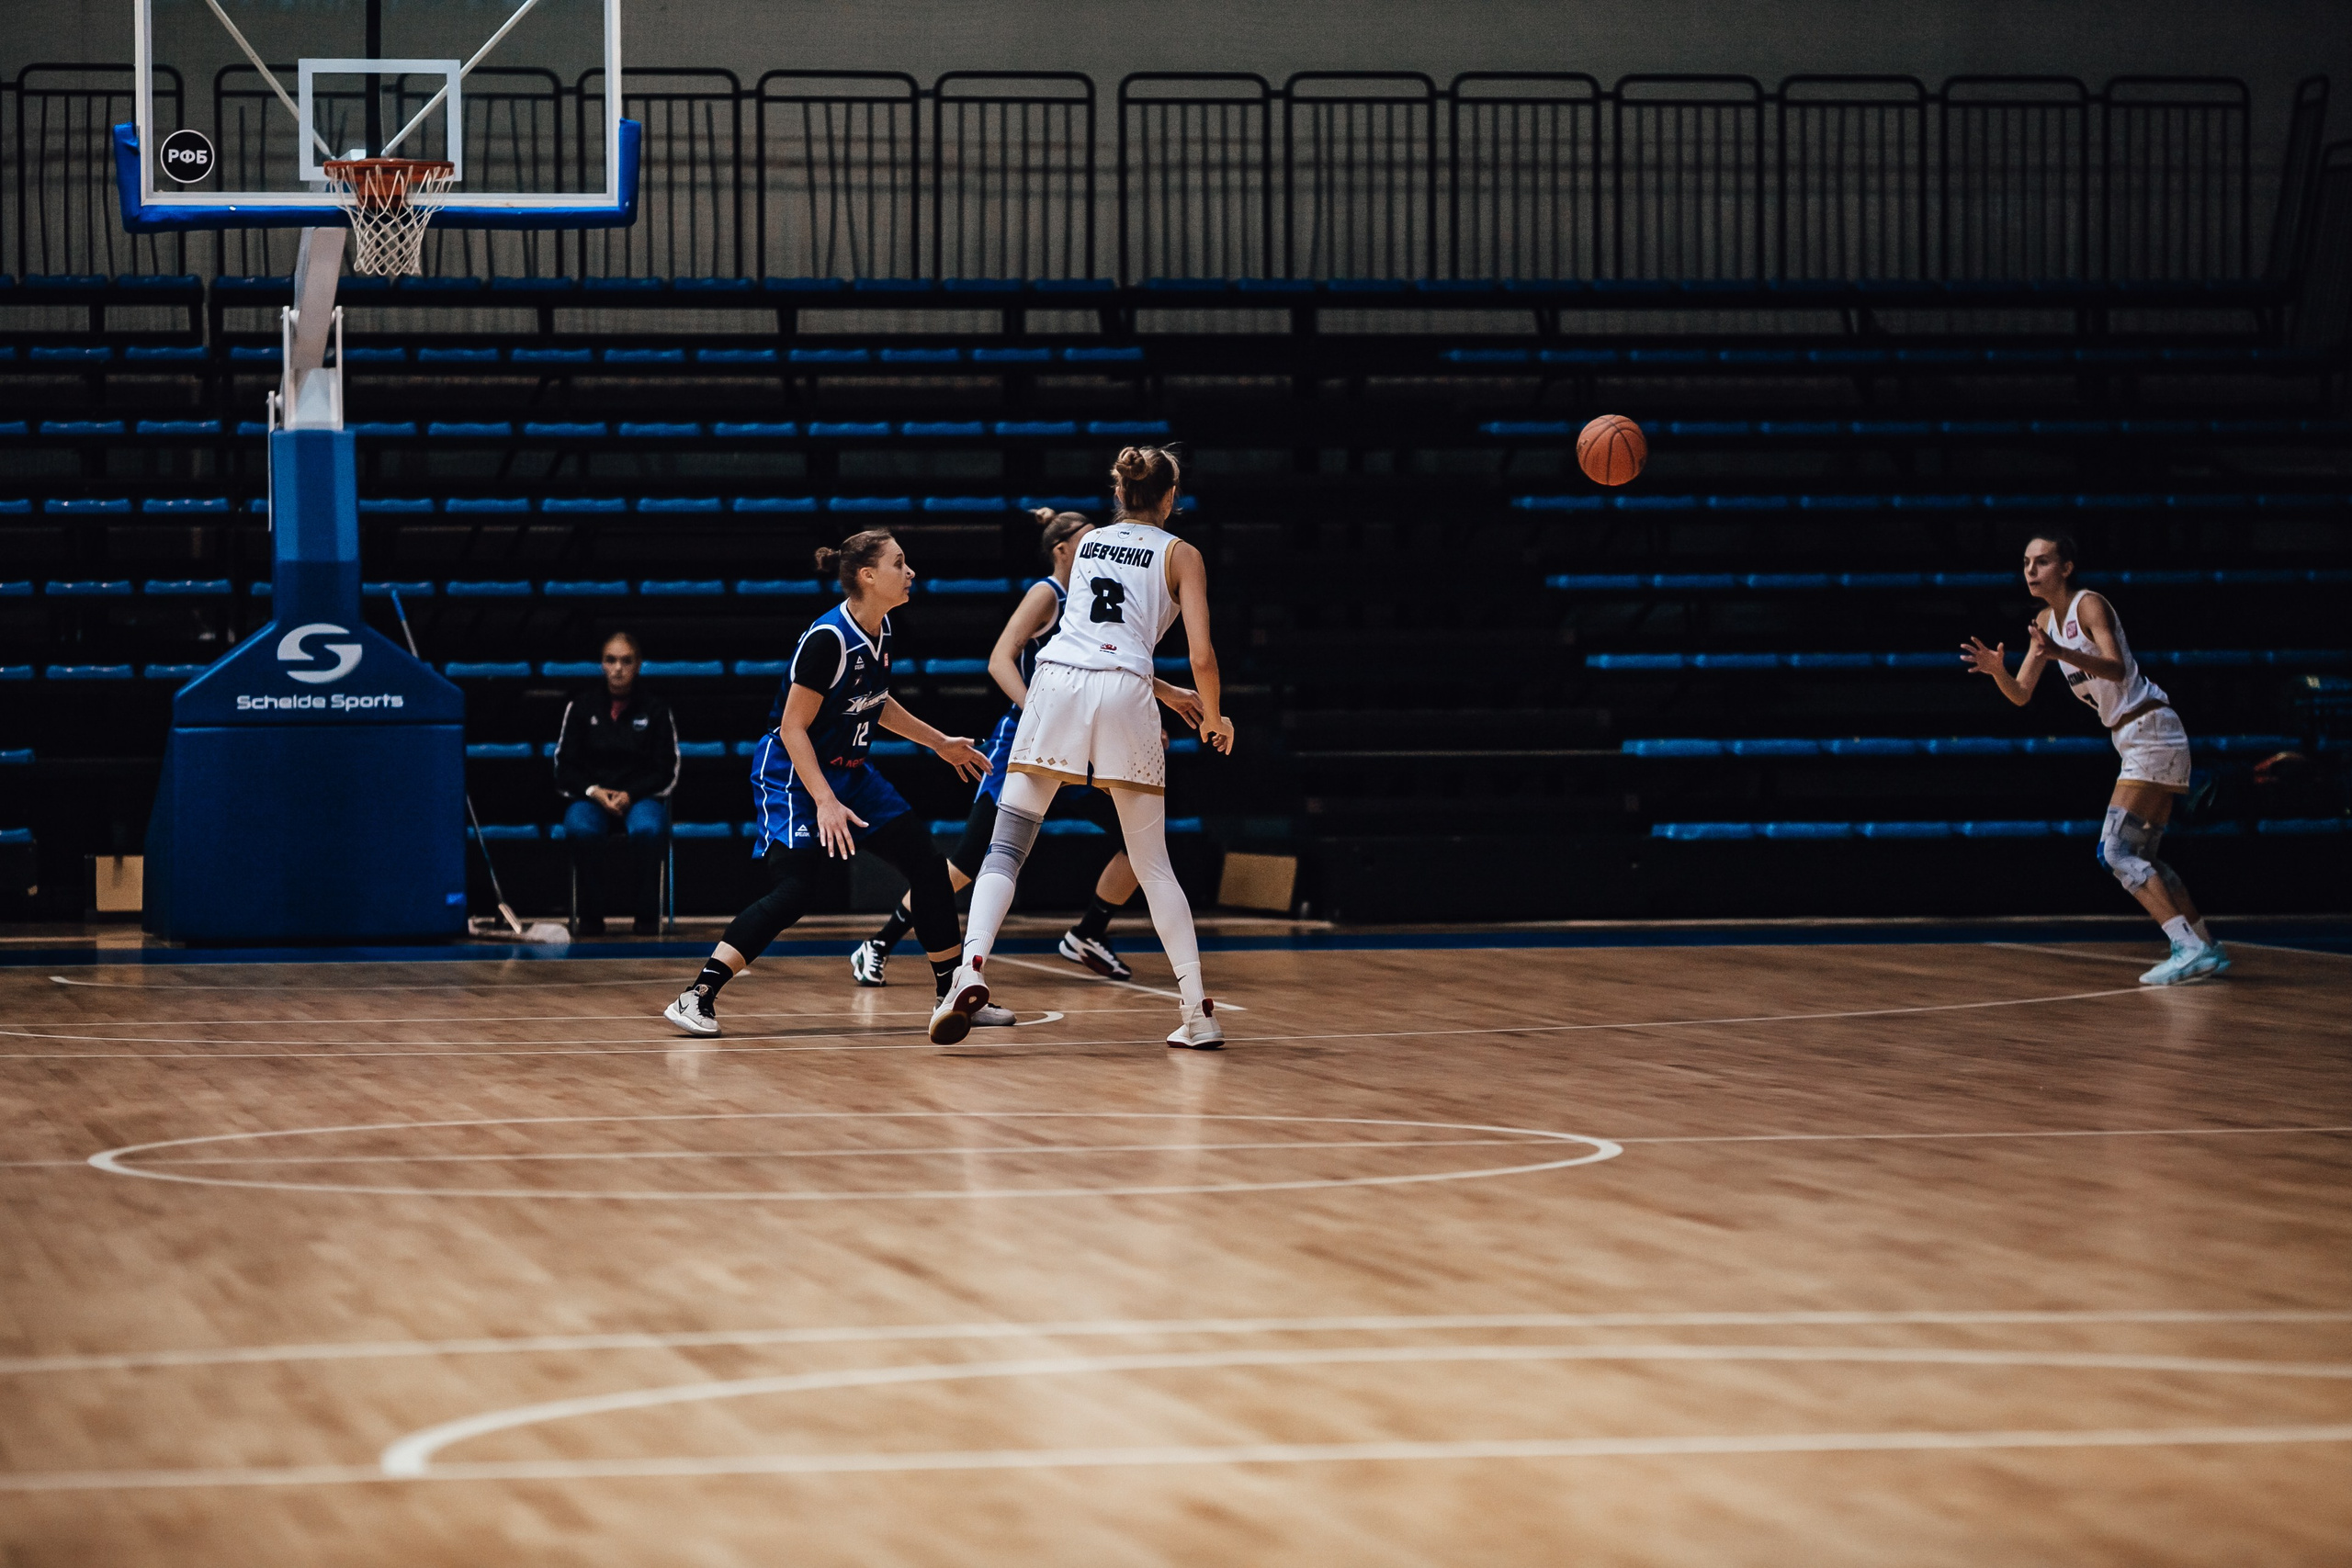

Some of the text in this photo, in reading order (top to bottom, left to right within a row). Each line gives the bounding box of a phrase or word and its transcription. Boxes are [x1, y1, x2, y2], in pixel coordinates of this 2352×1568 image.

[167, 148, 209, 164] РФБ
[1079, 542, 1155, 569] ШЕВЧЕНКО
[1090, 577, 1125, 624] 8
[235, 693, 404, 713] Schelde Sports
[852, 720, 870, 747] 12
